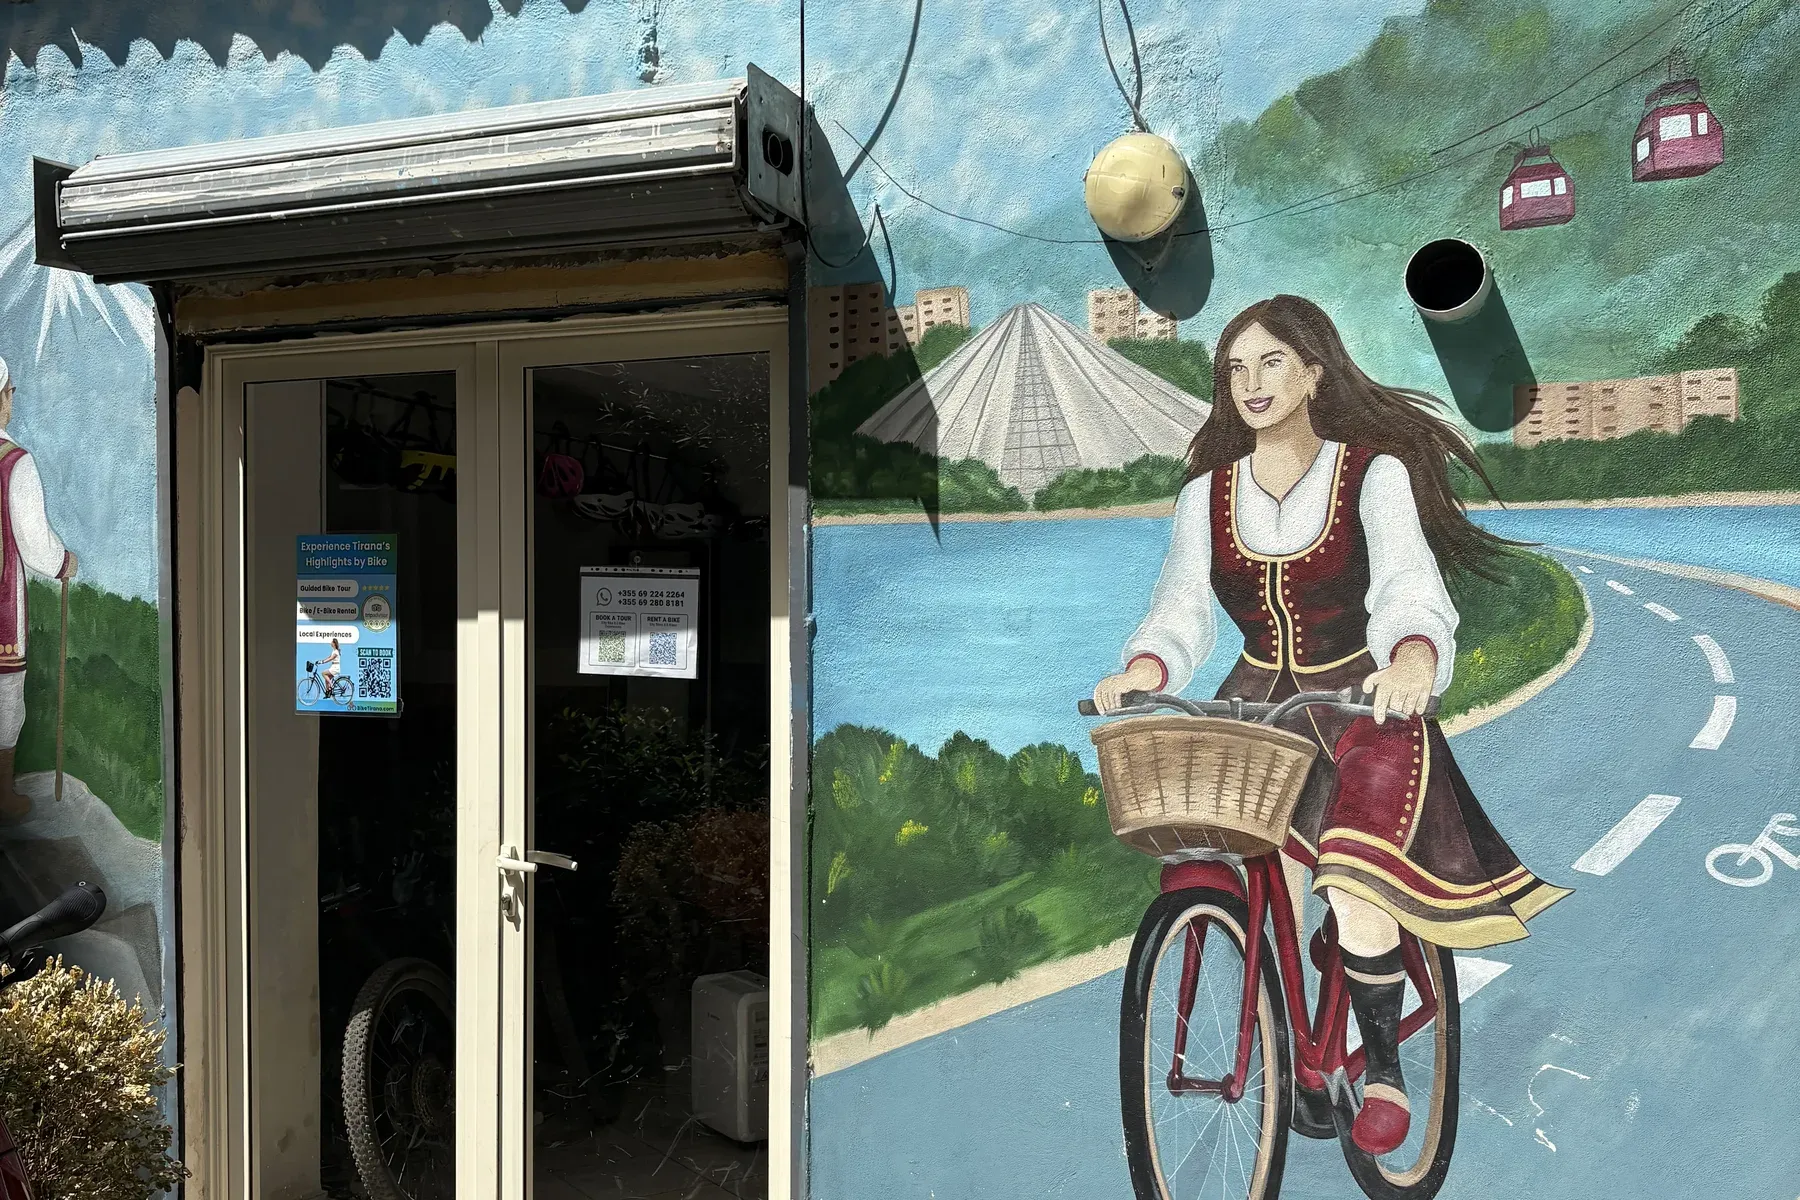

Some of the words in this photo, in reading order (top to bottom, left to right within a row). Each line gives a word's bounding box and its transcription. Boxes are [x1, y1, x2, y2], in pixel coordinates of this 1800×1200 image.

[301, 541, 351, 553] Experience
[352, 541, 391, 550] Tirana's
[306, 557, 352, 568] Highlights
[354, 557, 365, 568] by
[367, 557, 387, 566] Bike
[316, 631, 352, 639] Experiences
